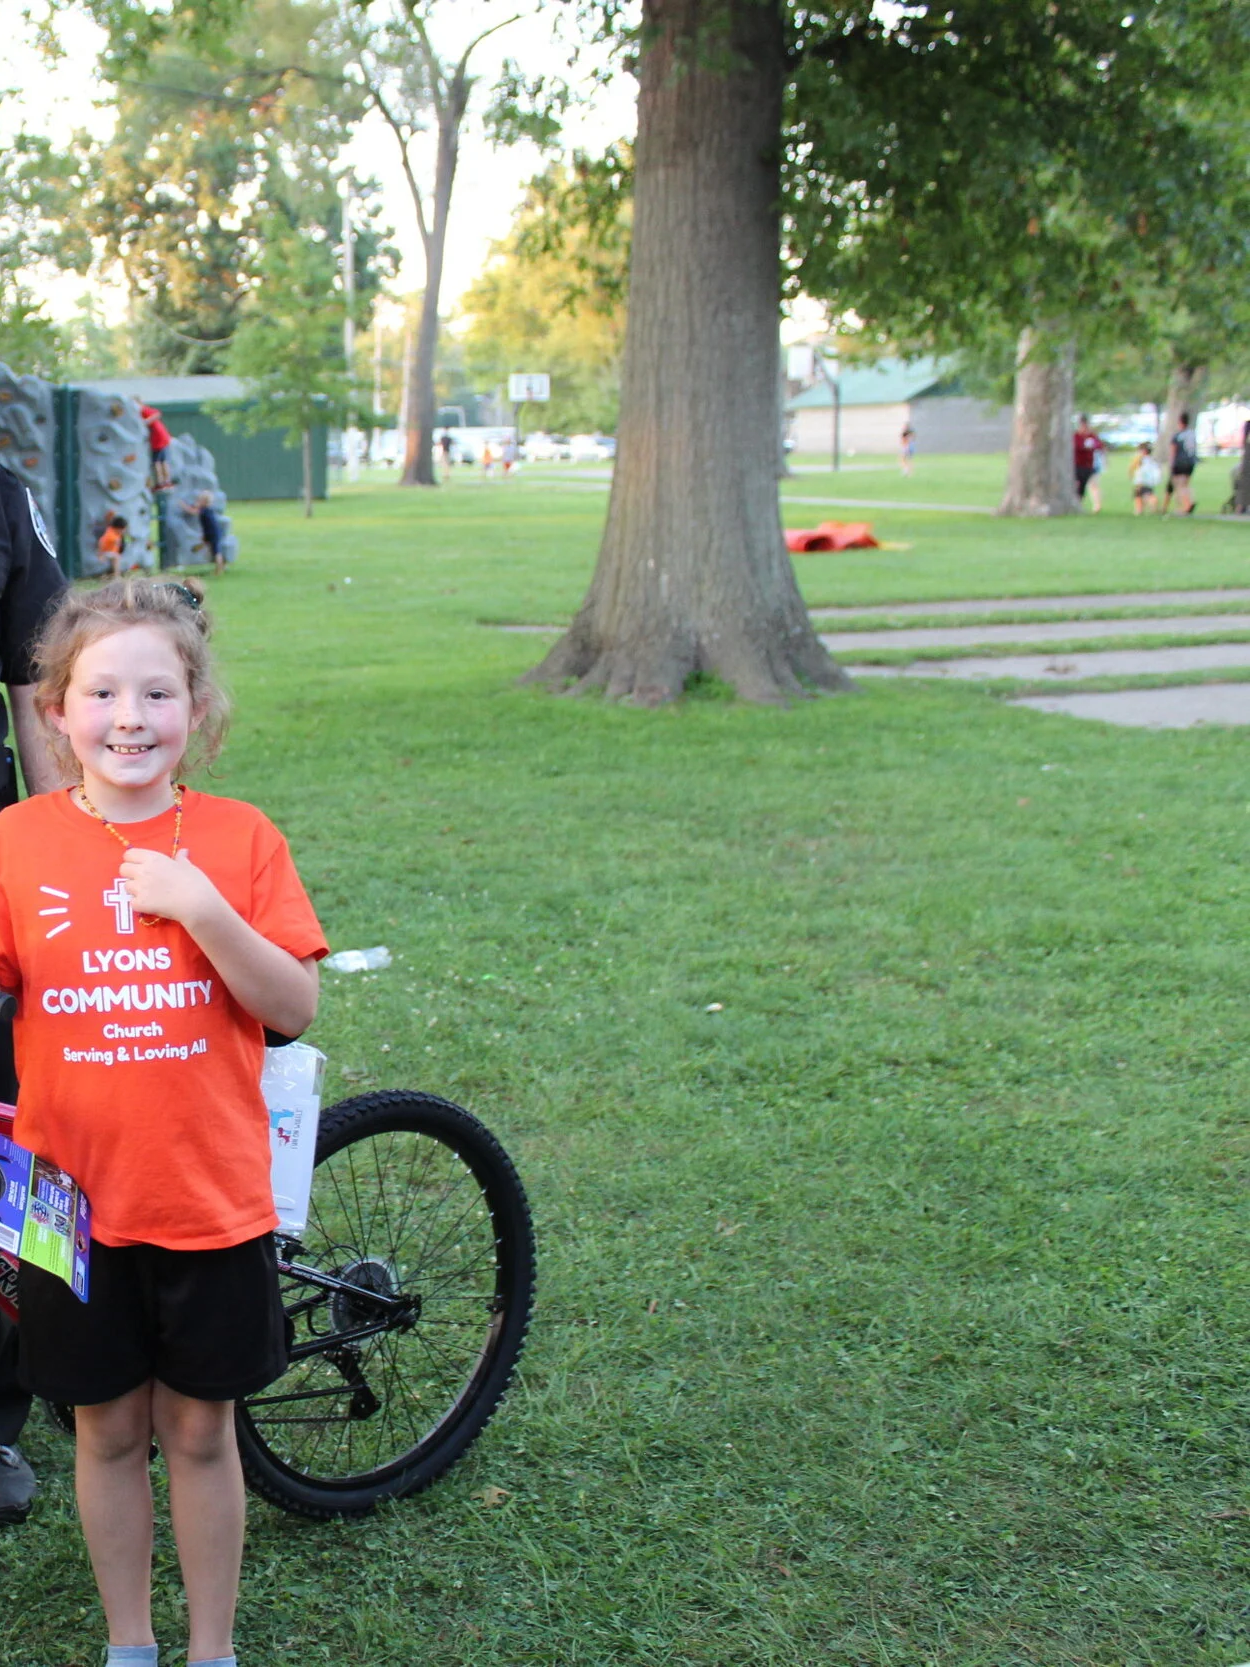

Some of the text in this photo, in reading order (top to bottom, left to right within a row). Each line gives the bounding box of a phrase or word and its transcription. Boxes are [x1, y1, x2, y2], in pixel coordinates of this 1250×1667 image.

[82, 946, 171, 974] LYONS
[41, 979, 213, 1015] COMMUNITY
[102, 1021, 163, 1039] Church
[62, 1039, 207, 1066] Serving & Loving All
